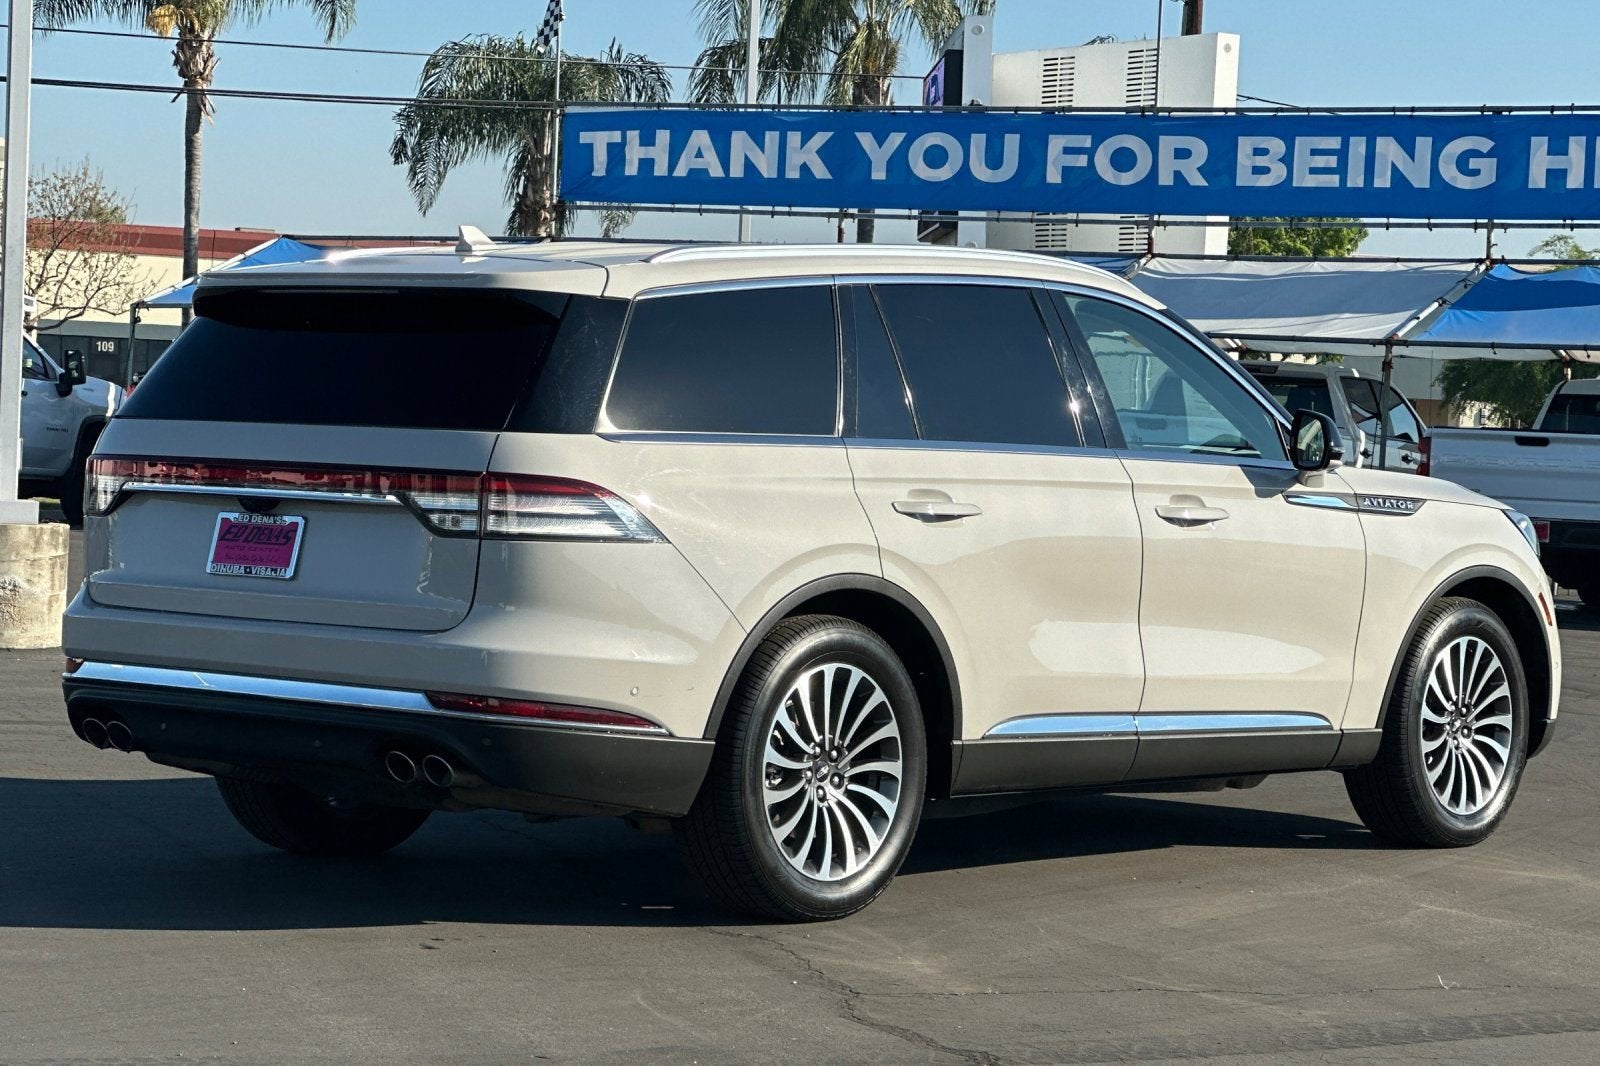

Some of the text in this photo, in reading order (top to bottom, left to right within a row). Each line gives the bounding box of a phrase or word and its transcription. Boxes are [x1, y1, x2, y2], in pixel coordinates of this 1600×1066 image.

[579, 129, 1600, 190] THANK YOU FOR BEING H
[96, 341, 114, 352] 109
[1363, 497, 1414, 509] AVIATOR
[238, 514, 282, 524] ED DENA'S
[211, 564, 245, 574] DINUBA
